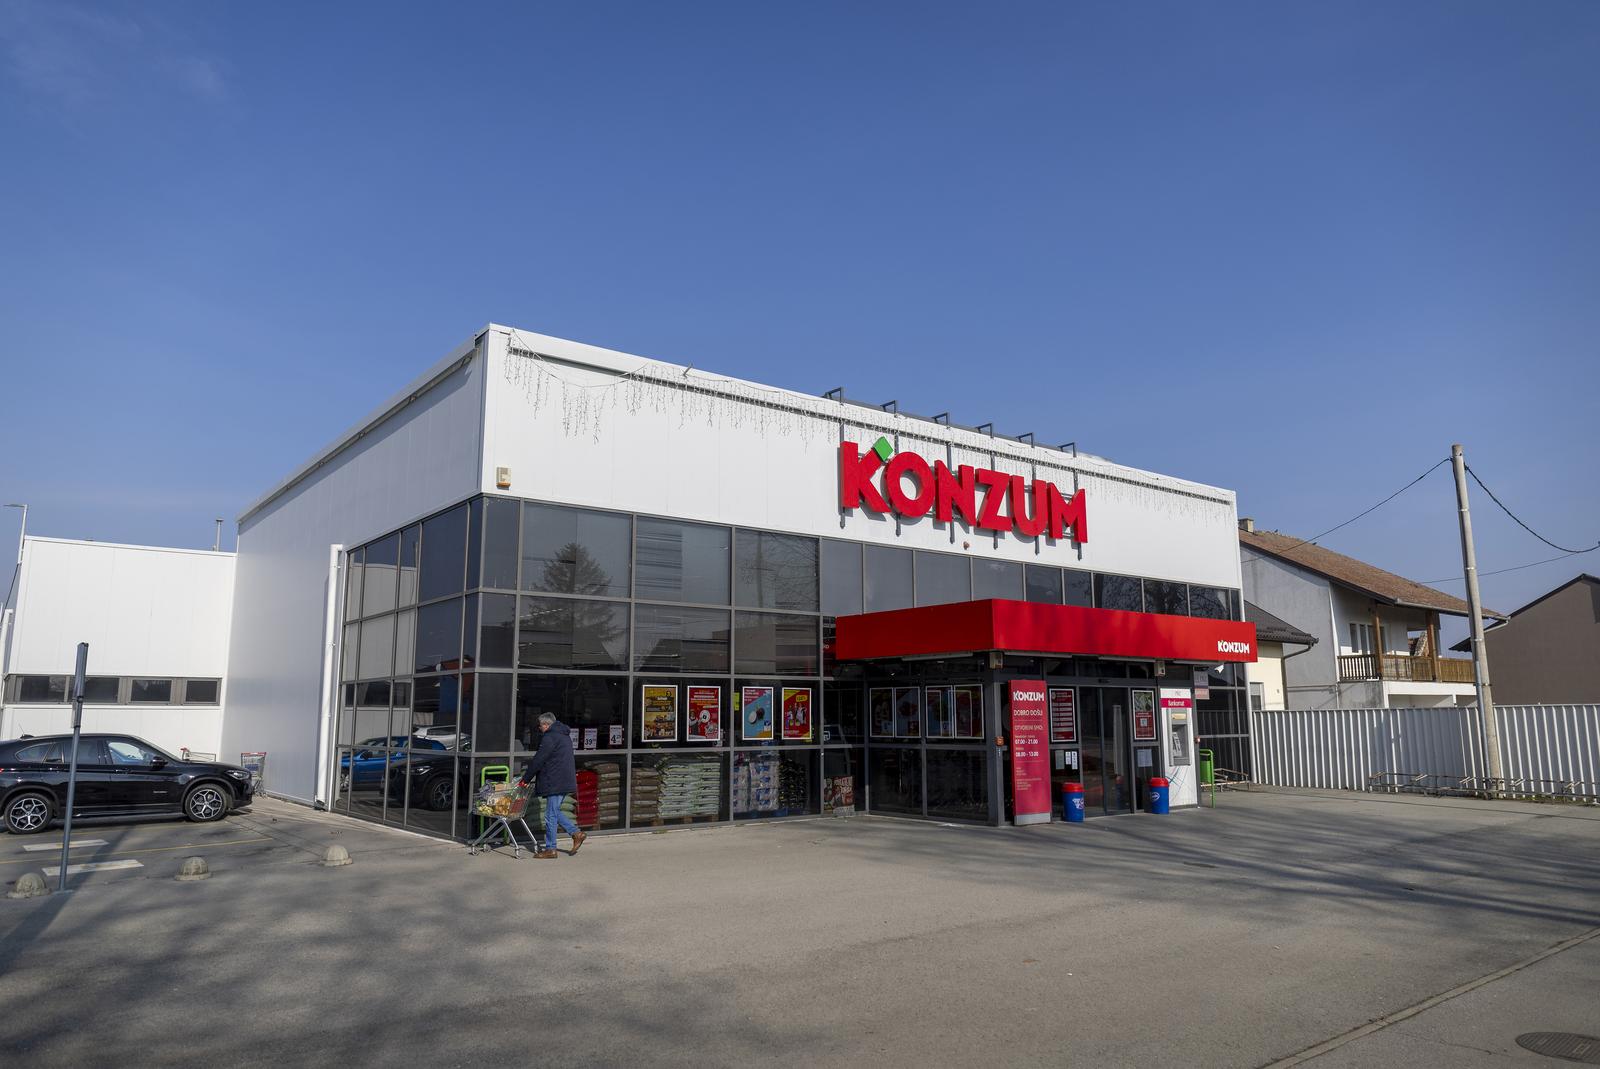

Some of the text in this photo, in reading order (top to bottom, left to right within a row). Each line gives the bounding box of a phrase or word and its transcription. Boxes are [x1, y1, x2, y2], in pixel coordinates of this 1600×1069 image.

[840, 437, 1088, 543] KONZUM
[1217, 640, 1250, 654] KONZUM
[1013, 691, 1045, 701] KONZUM
